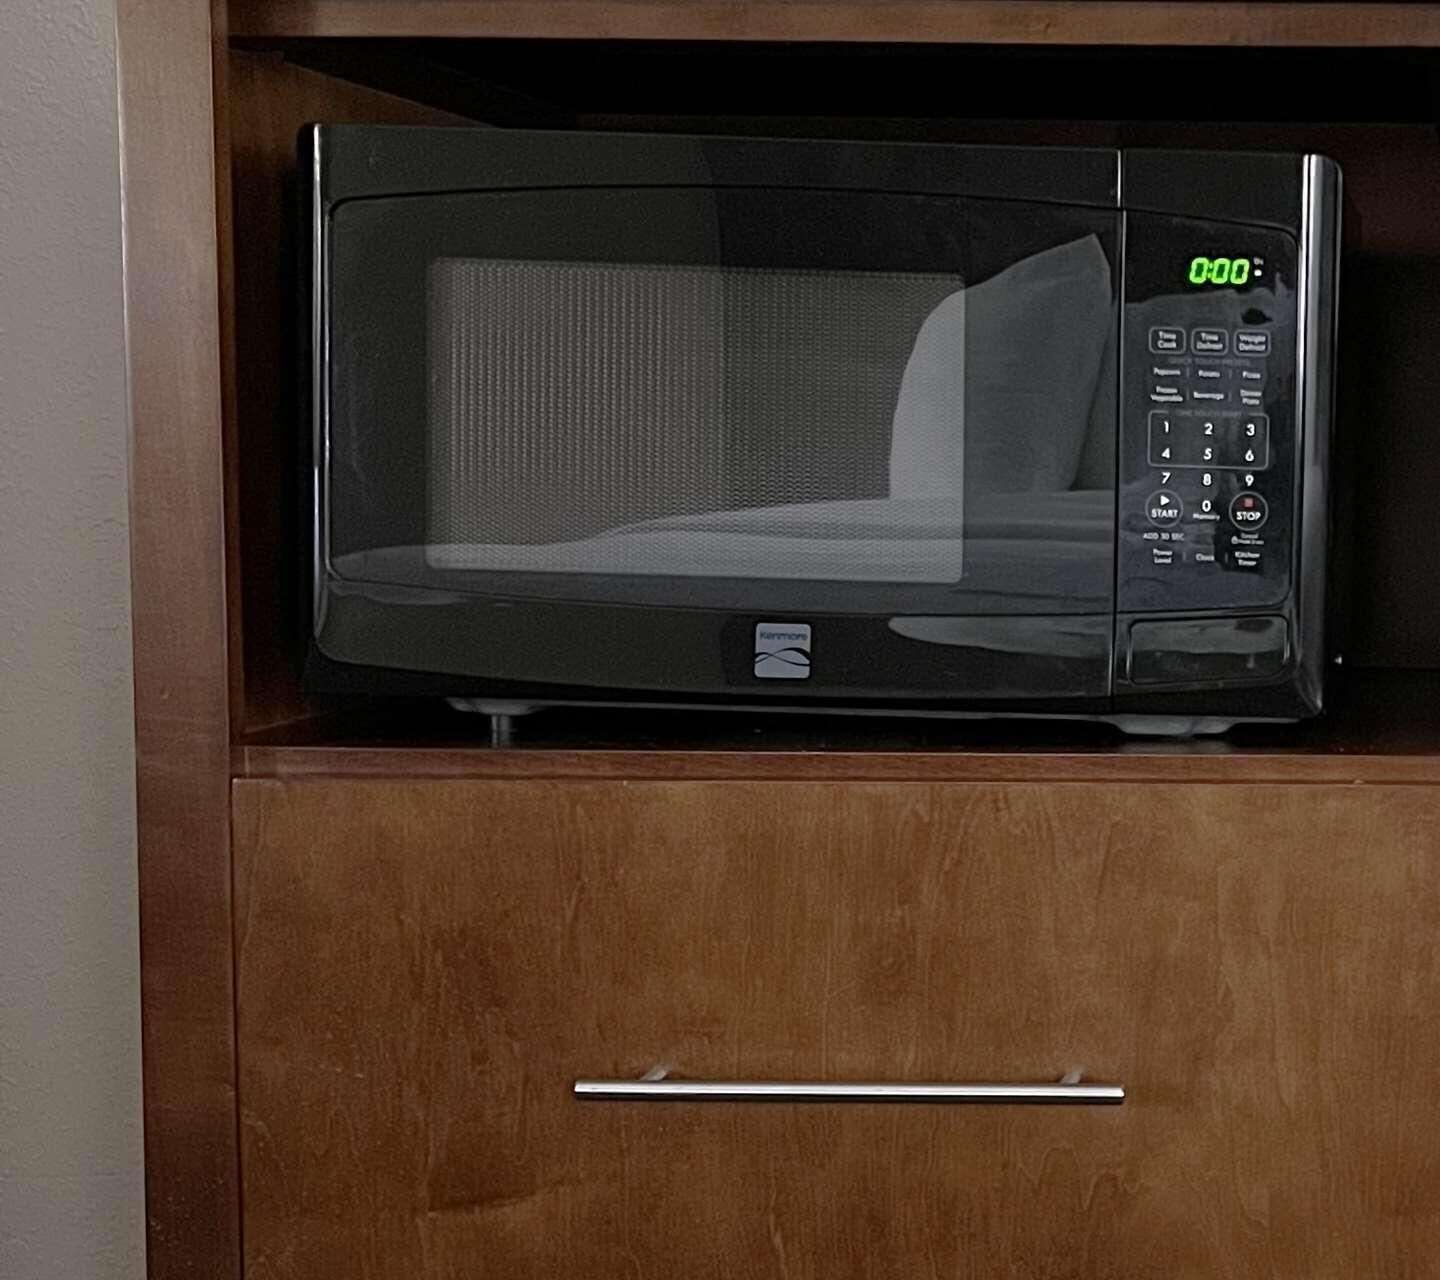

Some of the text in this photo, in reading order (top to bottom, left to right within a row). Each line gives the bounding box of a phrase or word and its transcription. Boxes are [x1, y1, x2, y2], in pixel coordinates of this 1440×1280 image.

[1189, 257, 1250, 285] 0:00
[1164, 421, 1255, 436] 1 2 3
[1161, 448, 1254, 462] 4 5 6
[1162, 472, 1254, 487] 7 8 9
[1151, 508, 1179, 518] START
[1202, 500, 1211, 512] 0
[1236, 511, 1261, 521] STOP
